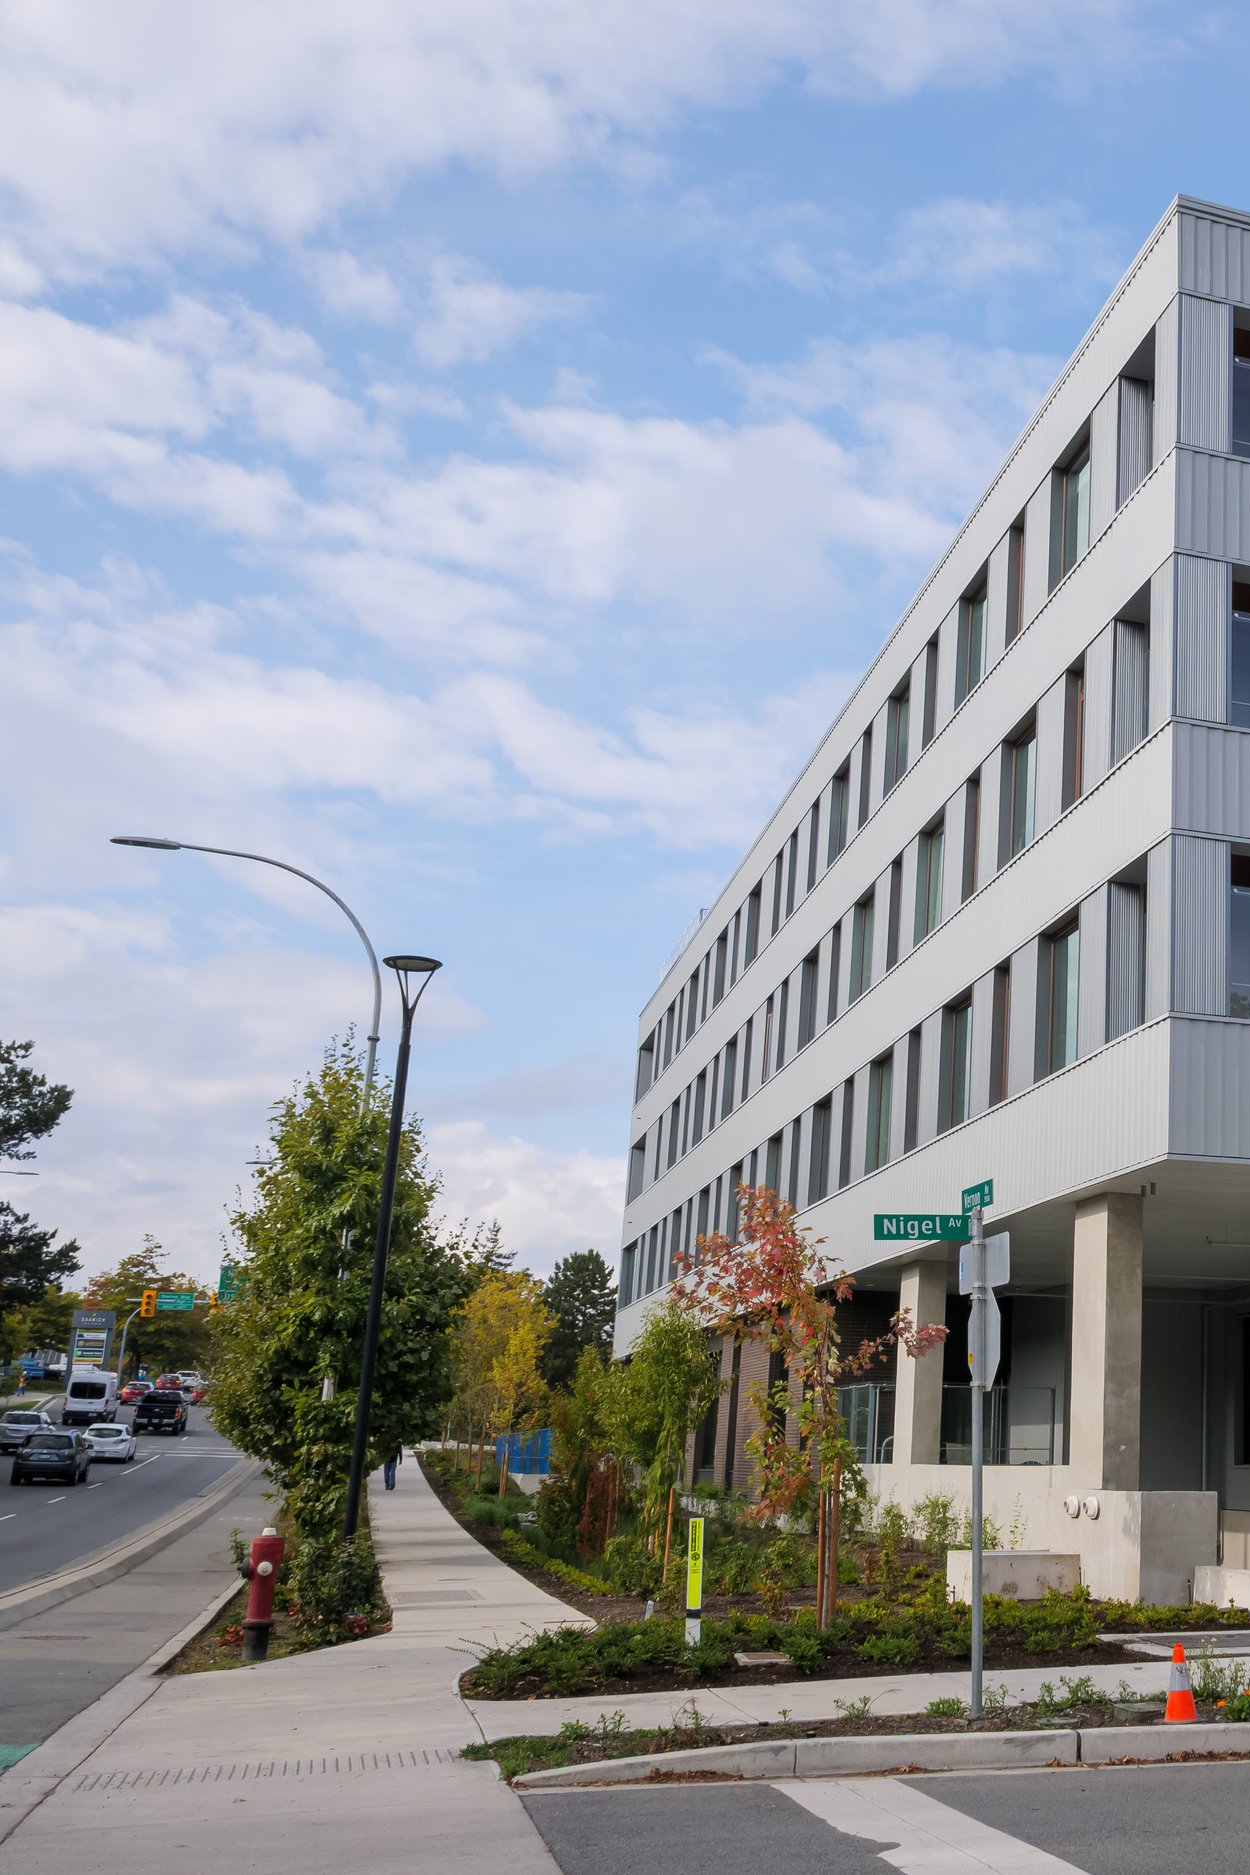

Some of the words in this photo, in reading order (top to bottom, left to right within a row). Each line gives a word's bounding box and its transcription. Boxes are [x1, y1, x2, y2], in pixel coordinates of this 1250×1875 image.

[964, 1192, 981, 1208] Vernon
[883, 1216, 942, 1239] Nigel
[948, 1217, 962, 1228] Av
